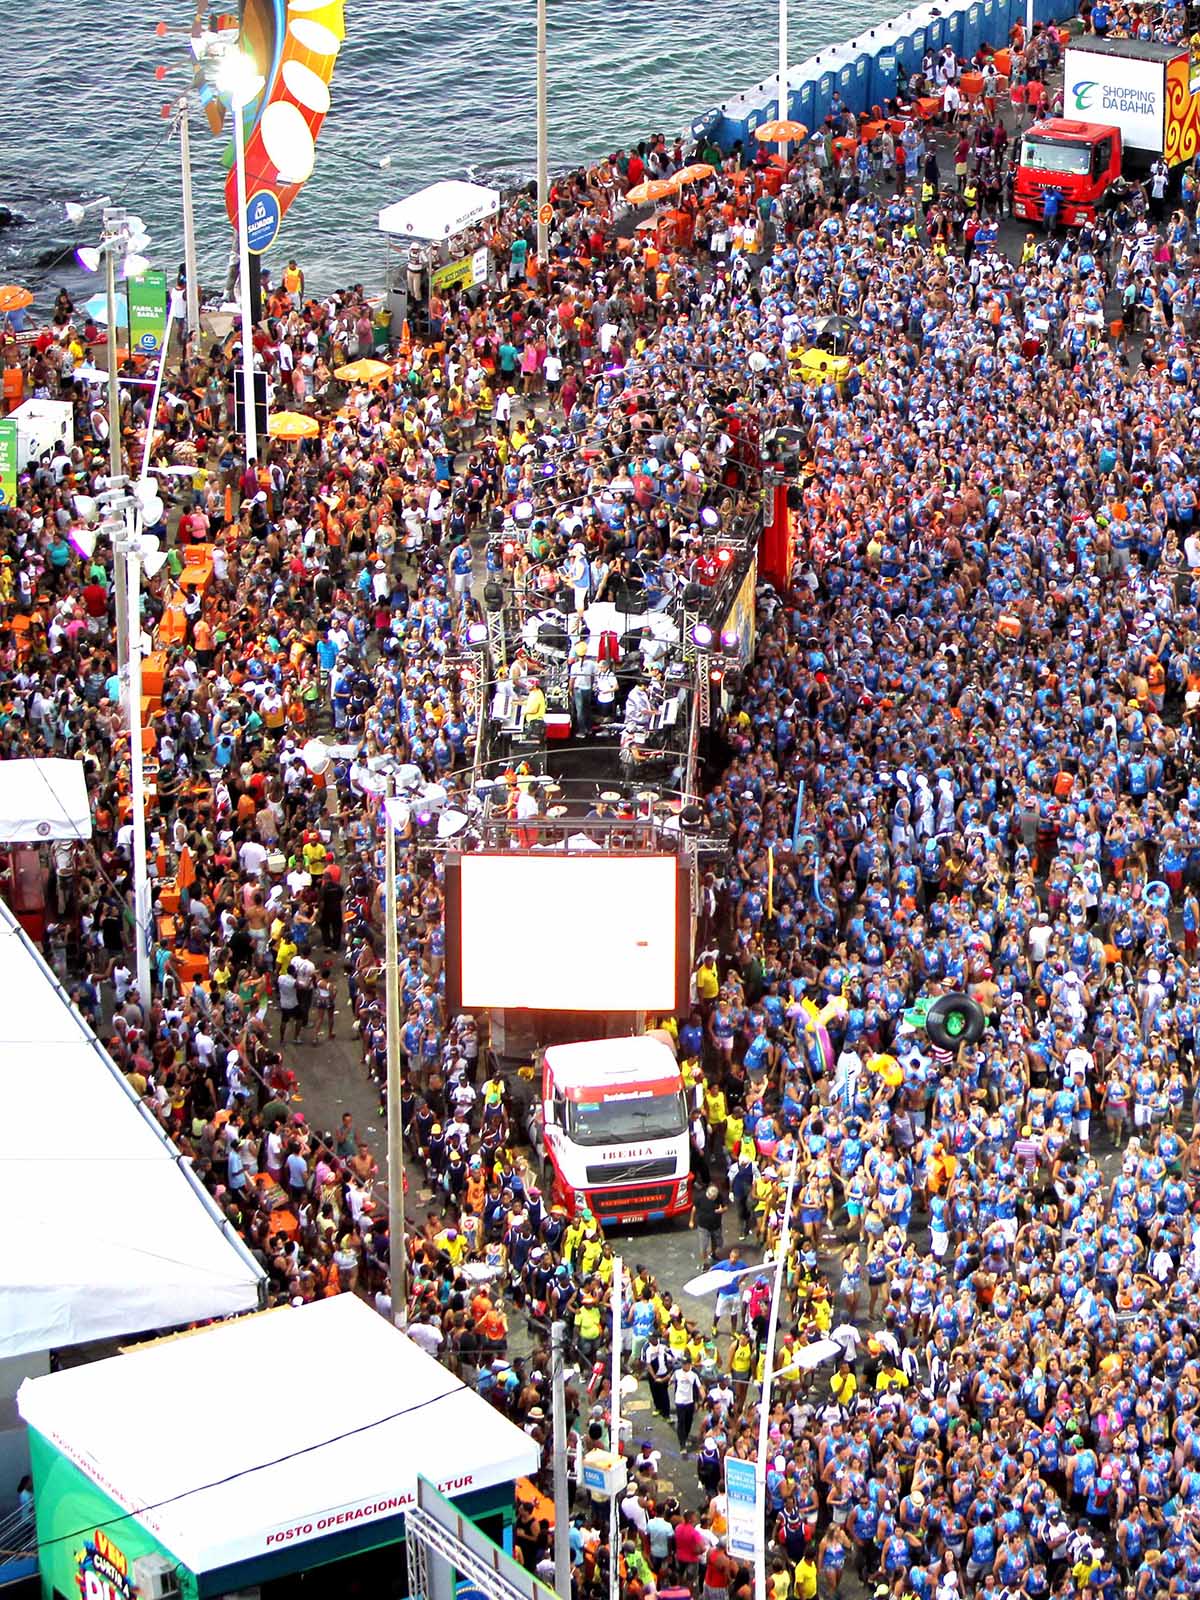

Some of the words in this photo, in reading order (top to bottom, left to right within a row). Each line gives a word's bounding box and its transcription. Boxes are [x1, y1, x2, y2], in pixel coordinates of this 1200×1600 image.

[1102, 85, 1156, 103] SHOPPING
[1102, 97, 1118, 110] DA
[1120, 100, 1155, 115] BAHIA
[602, 1148, 653, 1160] IBERIA
[266, 1522, 313, 1545] POSTO
[316, 1492, 416, 1530] OPERACIONAL
